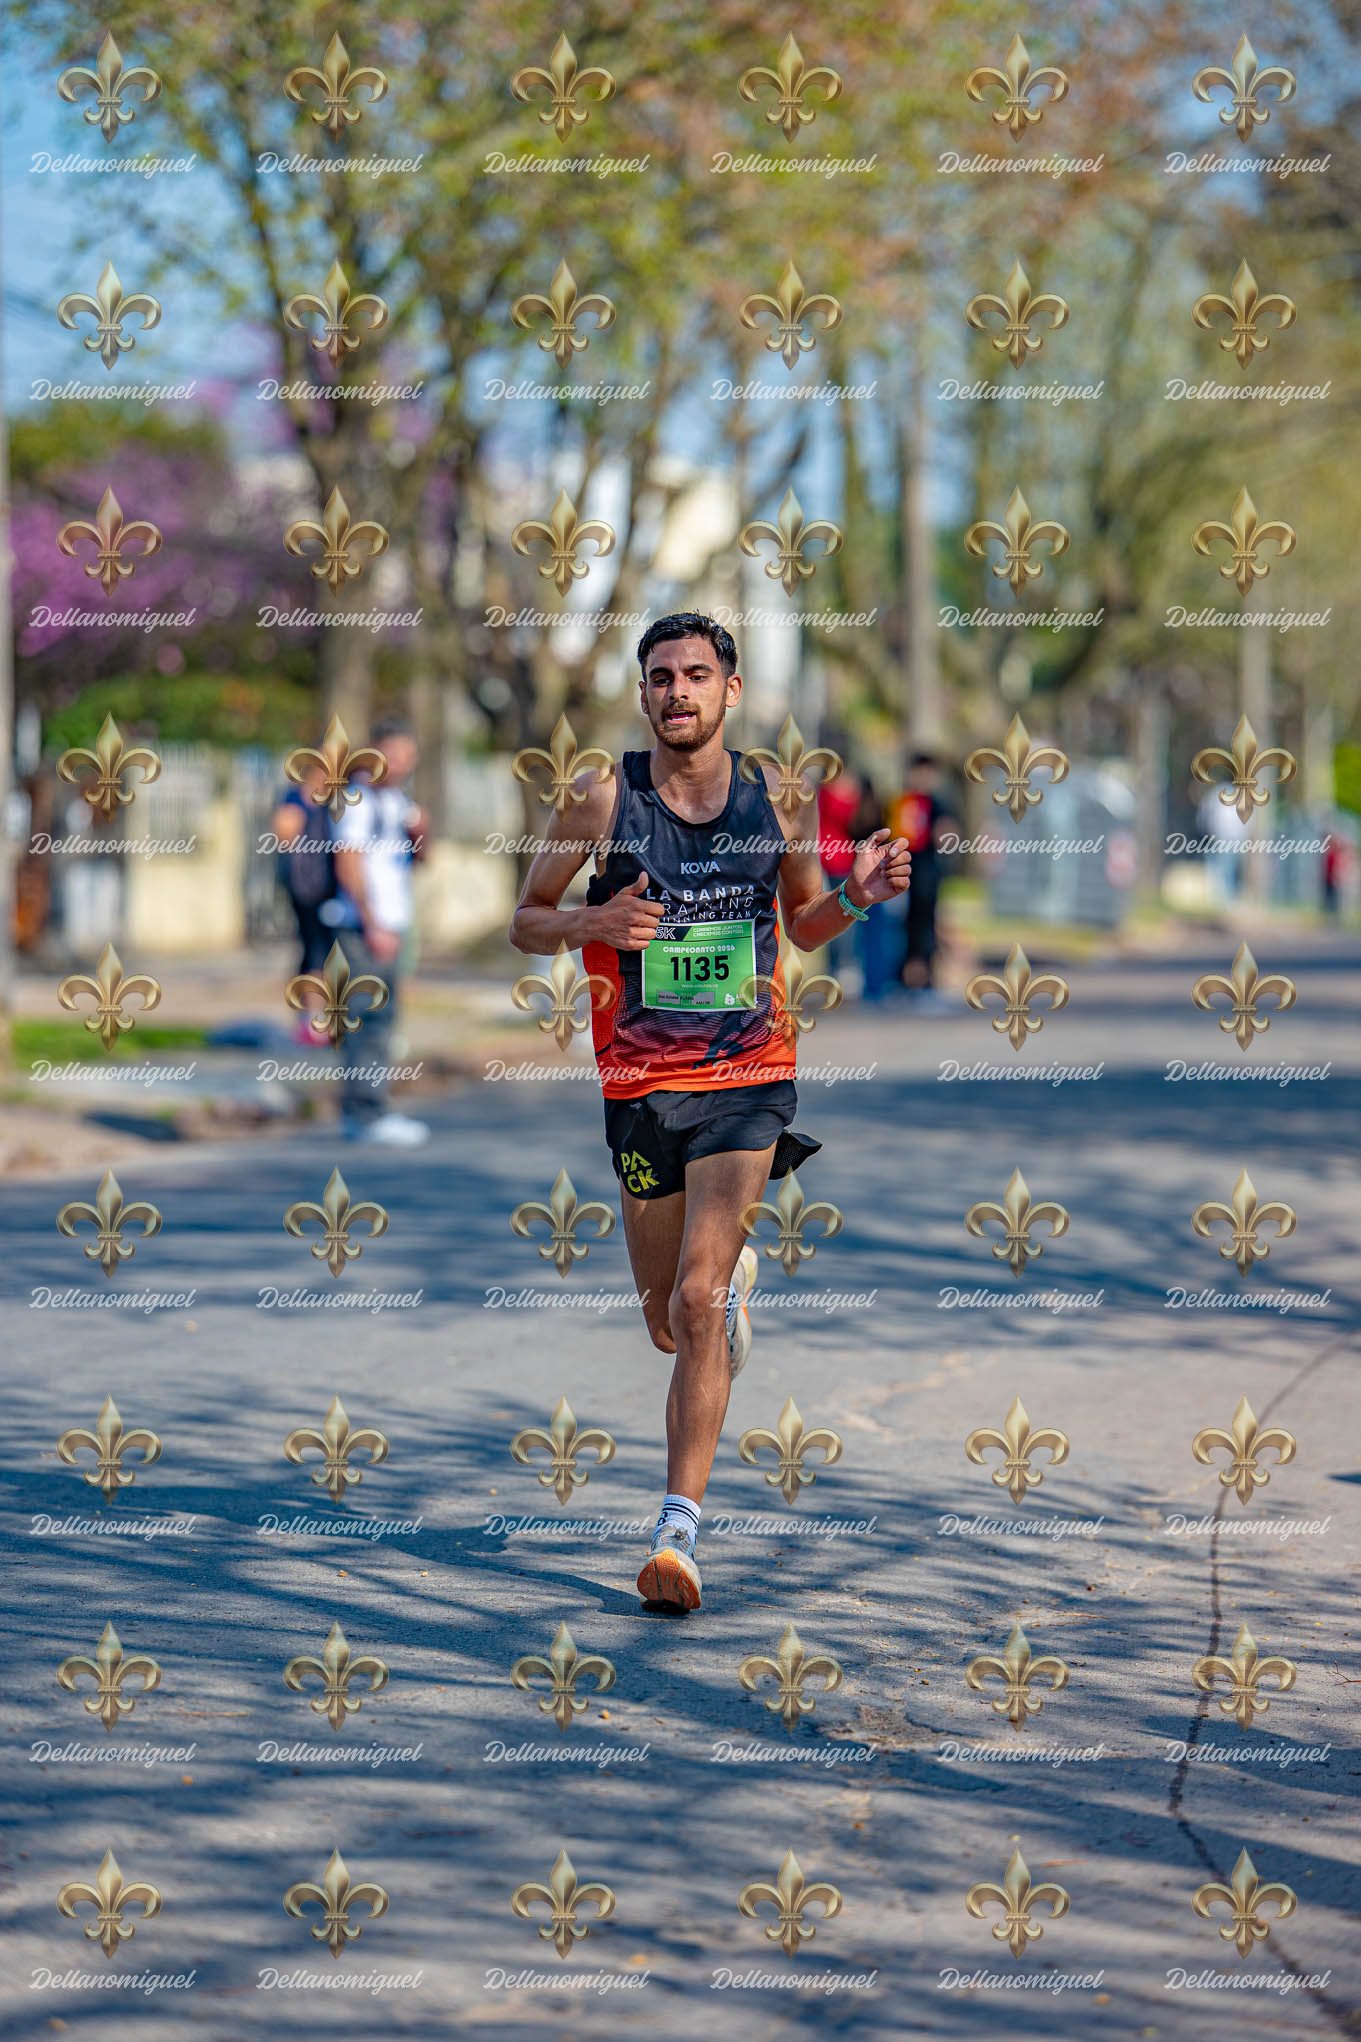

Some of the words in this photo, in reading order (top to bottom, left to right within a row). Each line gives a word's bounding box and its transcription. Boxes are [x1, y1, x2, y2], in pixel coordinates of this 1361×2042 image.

[680, 860, 721, 875] KOVA
[682, 884, 755, 902] BANDA
[663, 896, 754, 915] RAINING
[662, 911, 716, 923] UNNING
[655, 926, 676, 940] 5K
[662, 945, 716, 954] CAMPEONATO
[670, 954, 730, 982] 1135
